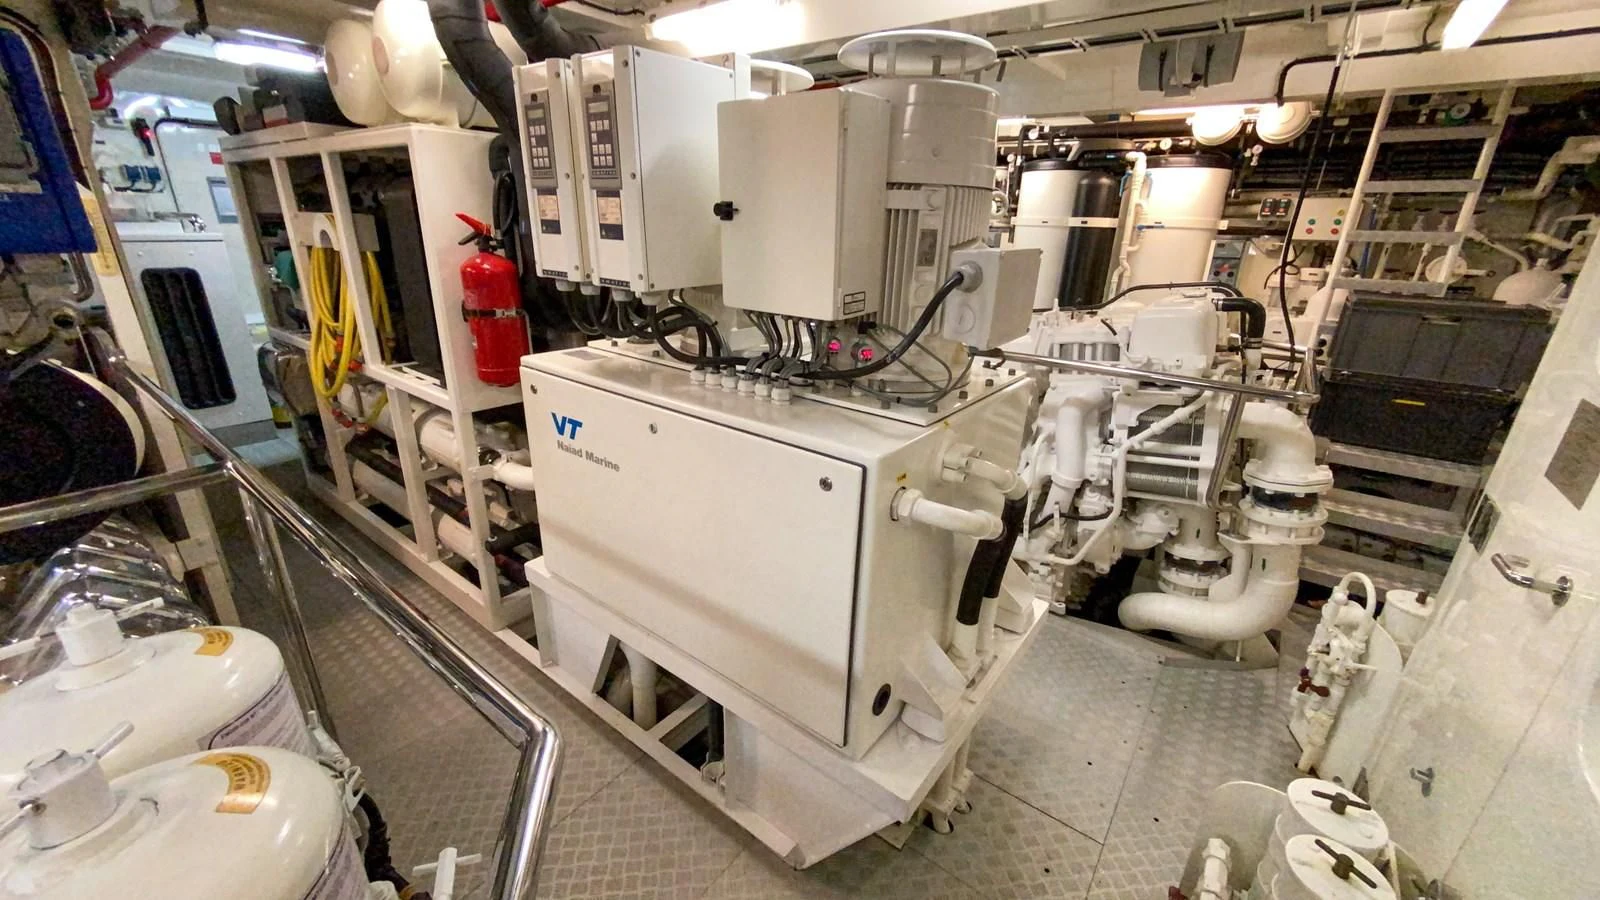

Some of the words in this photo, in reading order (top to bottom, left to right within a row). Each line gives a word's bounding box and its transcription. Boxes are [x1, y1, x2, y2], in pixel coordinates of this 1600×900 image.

[551, 411, 583, 440] VT
[557, 440, 583, 458] Naiad
[585, 450, 620, 472] Marine
